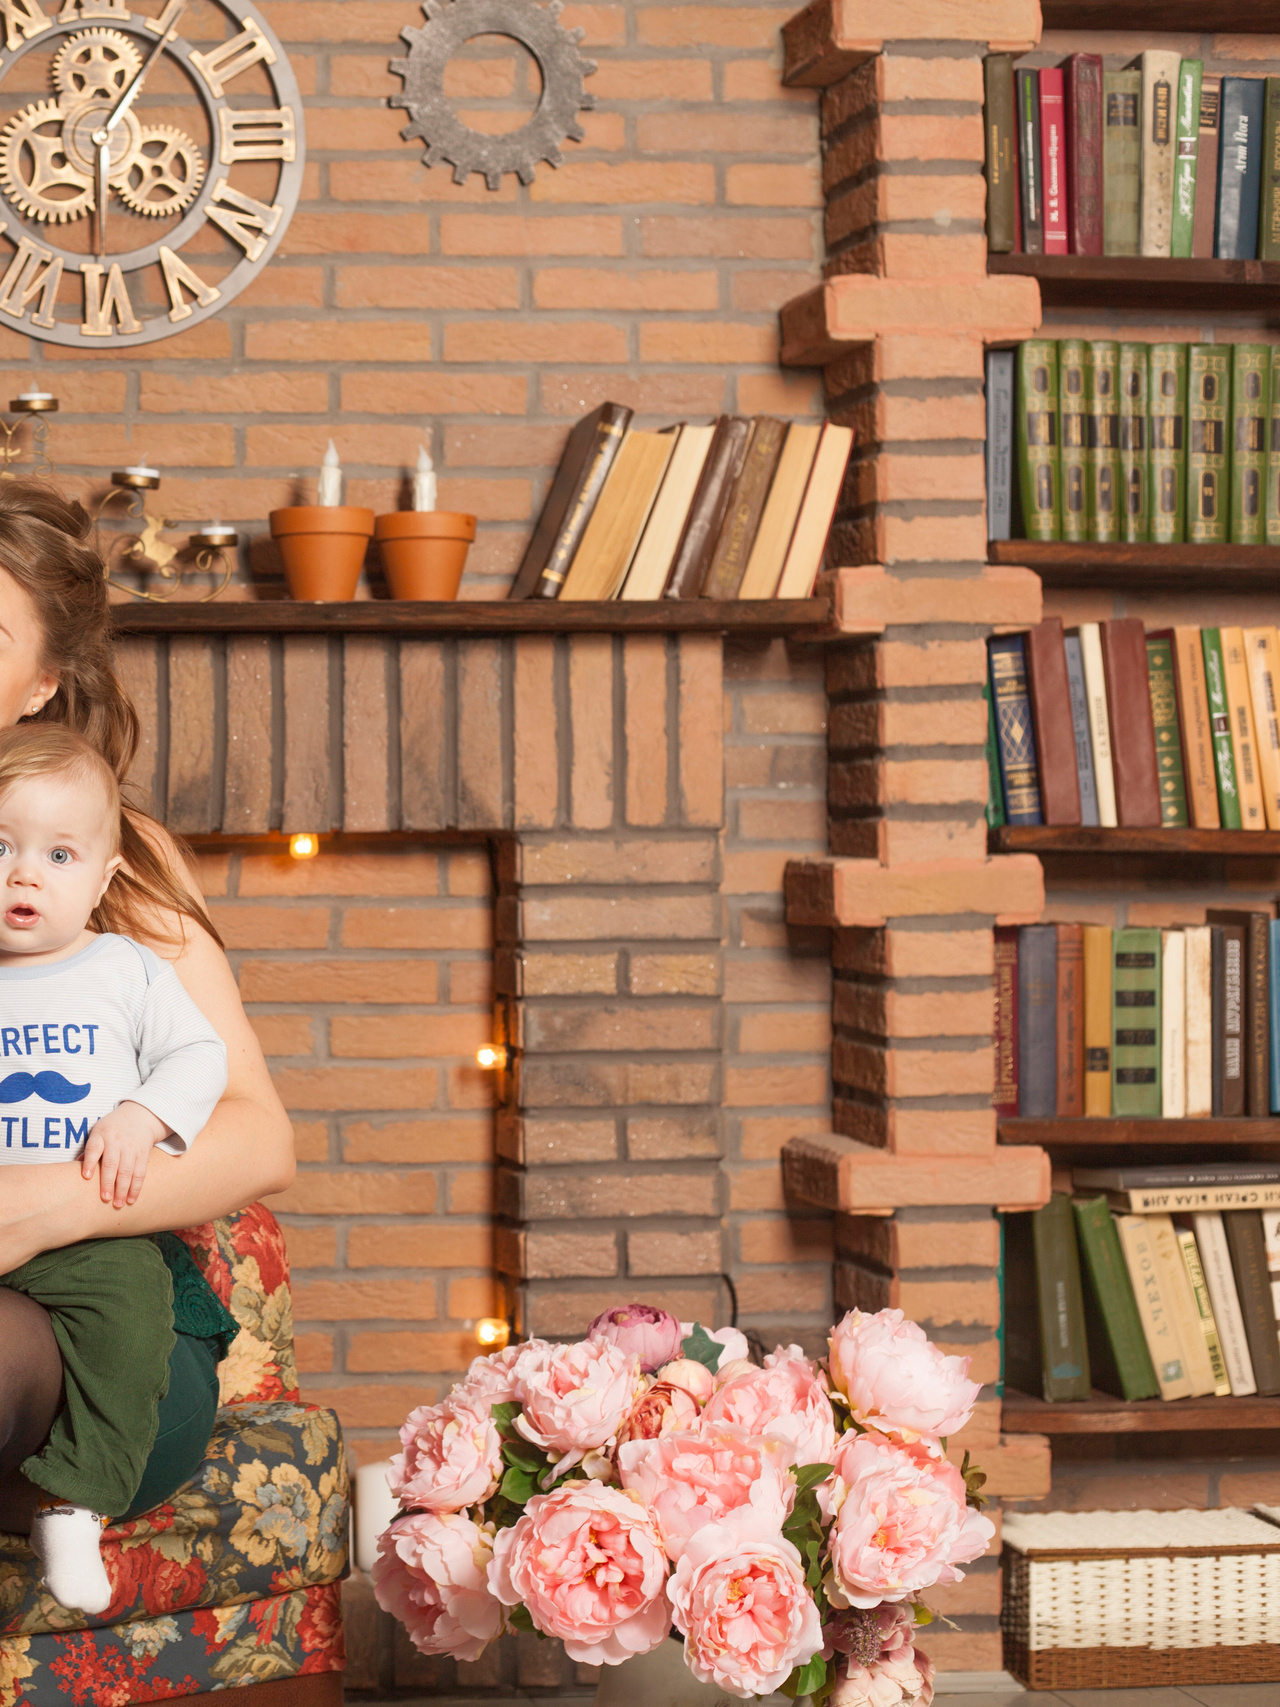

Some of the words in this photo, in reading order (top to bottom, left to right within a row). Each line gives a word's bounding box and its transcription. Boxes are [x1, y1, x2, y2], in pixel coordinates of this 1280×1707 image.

[189, 16, 277, 98] II
[217, 106, 296, 165] III
[204, 178, 283, 262] IV
[80, 263, 143, 336] VI
[159, 245, 221, 323] V
[1143, 1195, 1169, 1208] ДНЯ
[1175, 1194, 1208, 1206] БЕЛА
[1215, 1191, 1259, 1205] СРЕДИ
[1136, 1241, 1164, 1322] ЧЕХОВ
[1208, 1345, 1224, 1379] 1984
